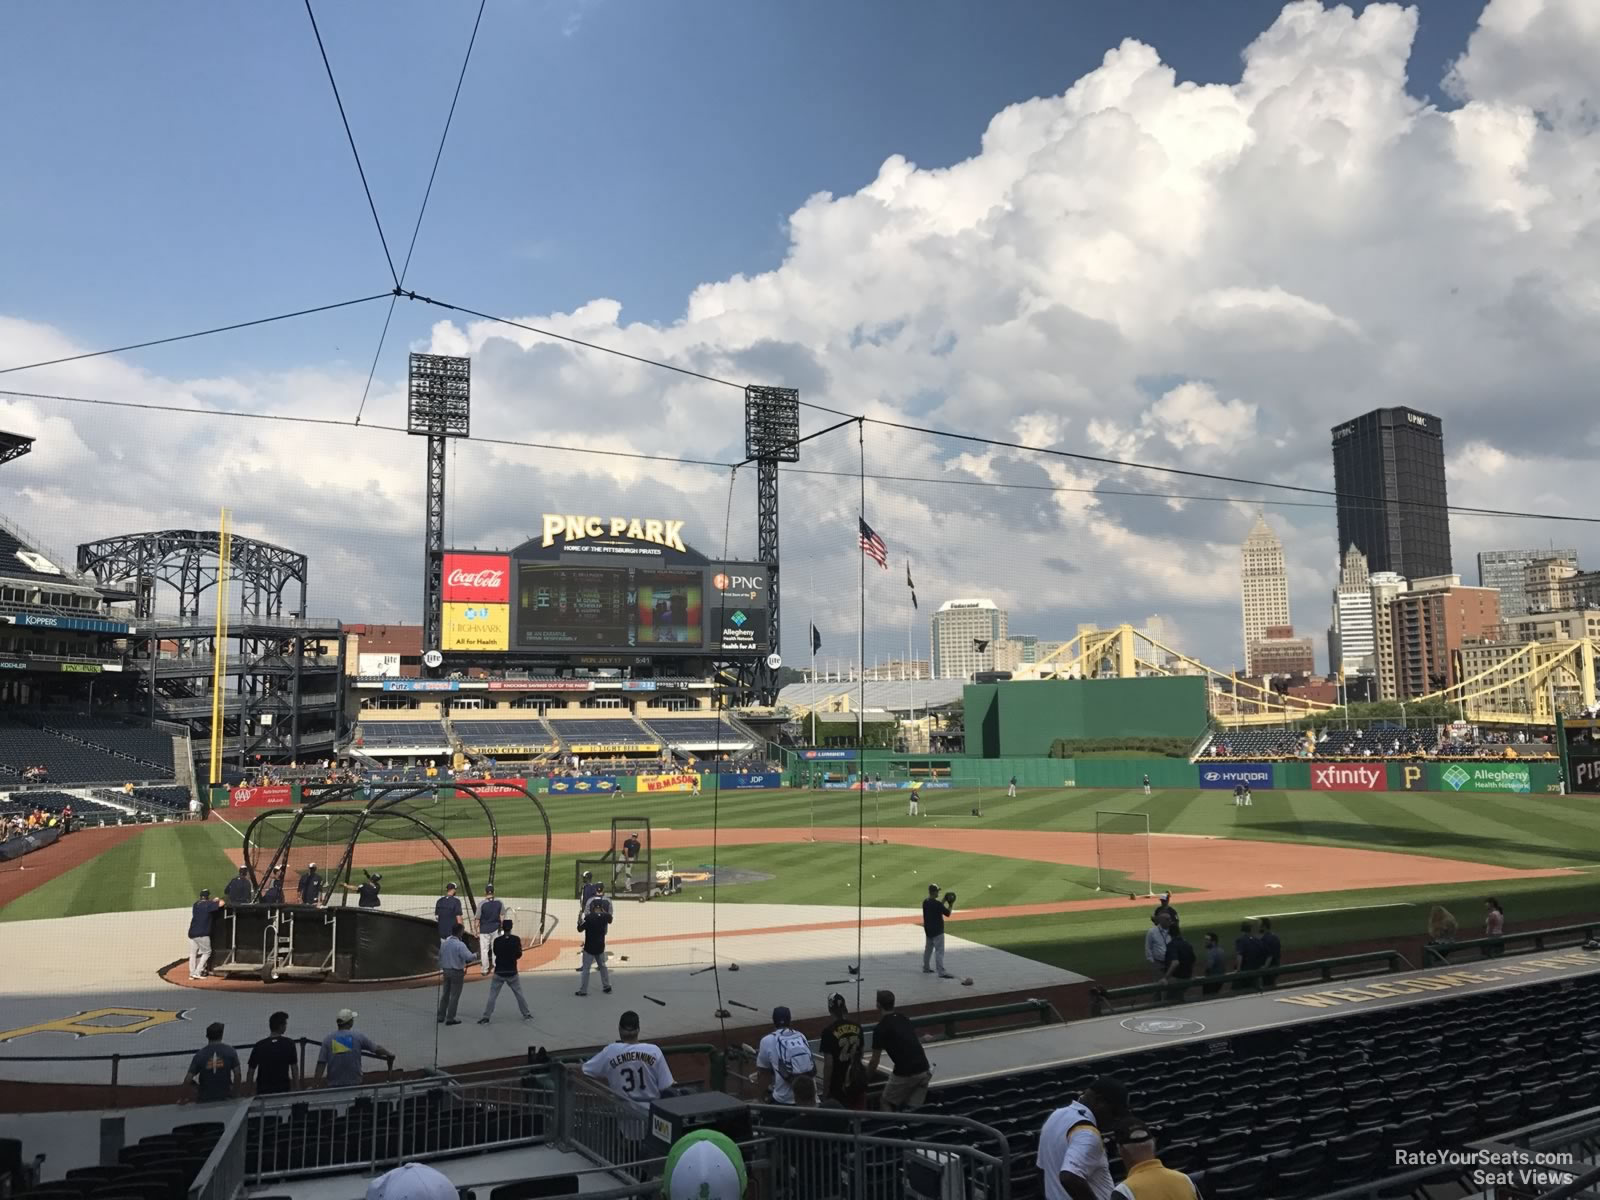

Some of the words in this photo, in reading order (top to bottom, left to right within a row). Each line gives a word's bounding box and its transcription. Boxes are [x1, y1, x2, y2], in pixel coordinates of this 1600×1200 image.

[1407, 413, 1427, 426] UPMC
[542, 513, 604, 548] PNC
[610, 517, 686, 552] PARK
[448, 569, 504, 587] Coca-Cola
[731, 576, 763, 589] PNC
[26, 615, 57, 626] KOPPERS
[723, 629, 754, 637] Allegheny
[384, 656, 398, 665] Lite
[426, 654, 441, 664] Lite
[769, 657, 780, 665] Lite
[1316, 766, 1380, 788] xfinity
[1404, 766, 1421, 788] P
[1474, 770, 1528, 782] Allegheny
[235, 791, 250, 801] AAA
[1274, 970, 1486, 1008] WELCOME
[609, 1052, 656, 1069] GLENDENNING
[620, 1067, 646, 1092] 31
